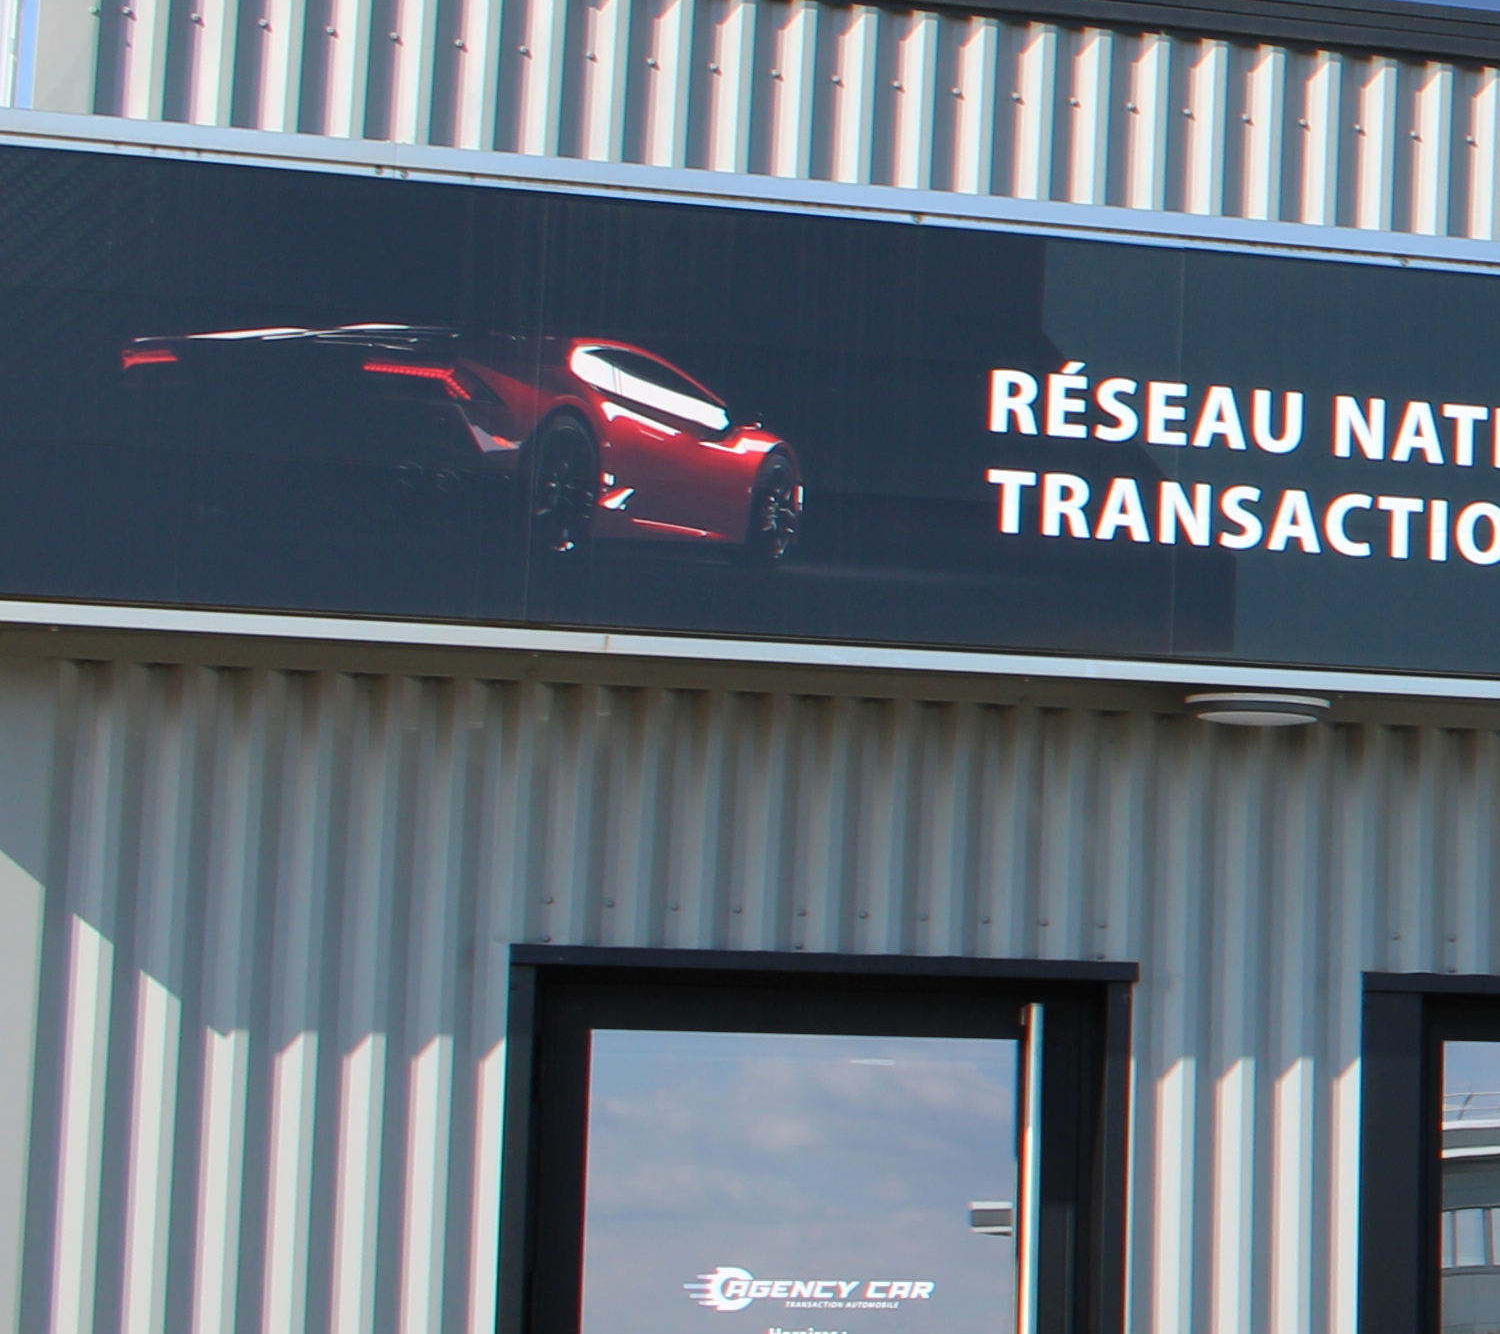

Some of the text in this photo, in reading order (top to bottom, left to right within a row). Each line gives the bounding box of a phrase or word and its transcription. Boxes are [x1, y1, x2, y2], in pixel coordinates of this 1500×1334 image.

[988, 360, 1305, 455] RÉSEAU
[727, 1279, 936, 1299] AGENCY CAR
[785, 1300, 900, 1309] TRANSACTION AUTOMOBILE
